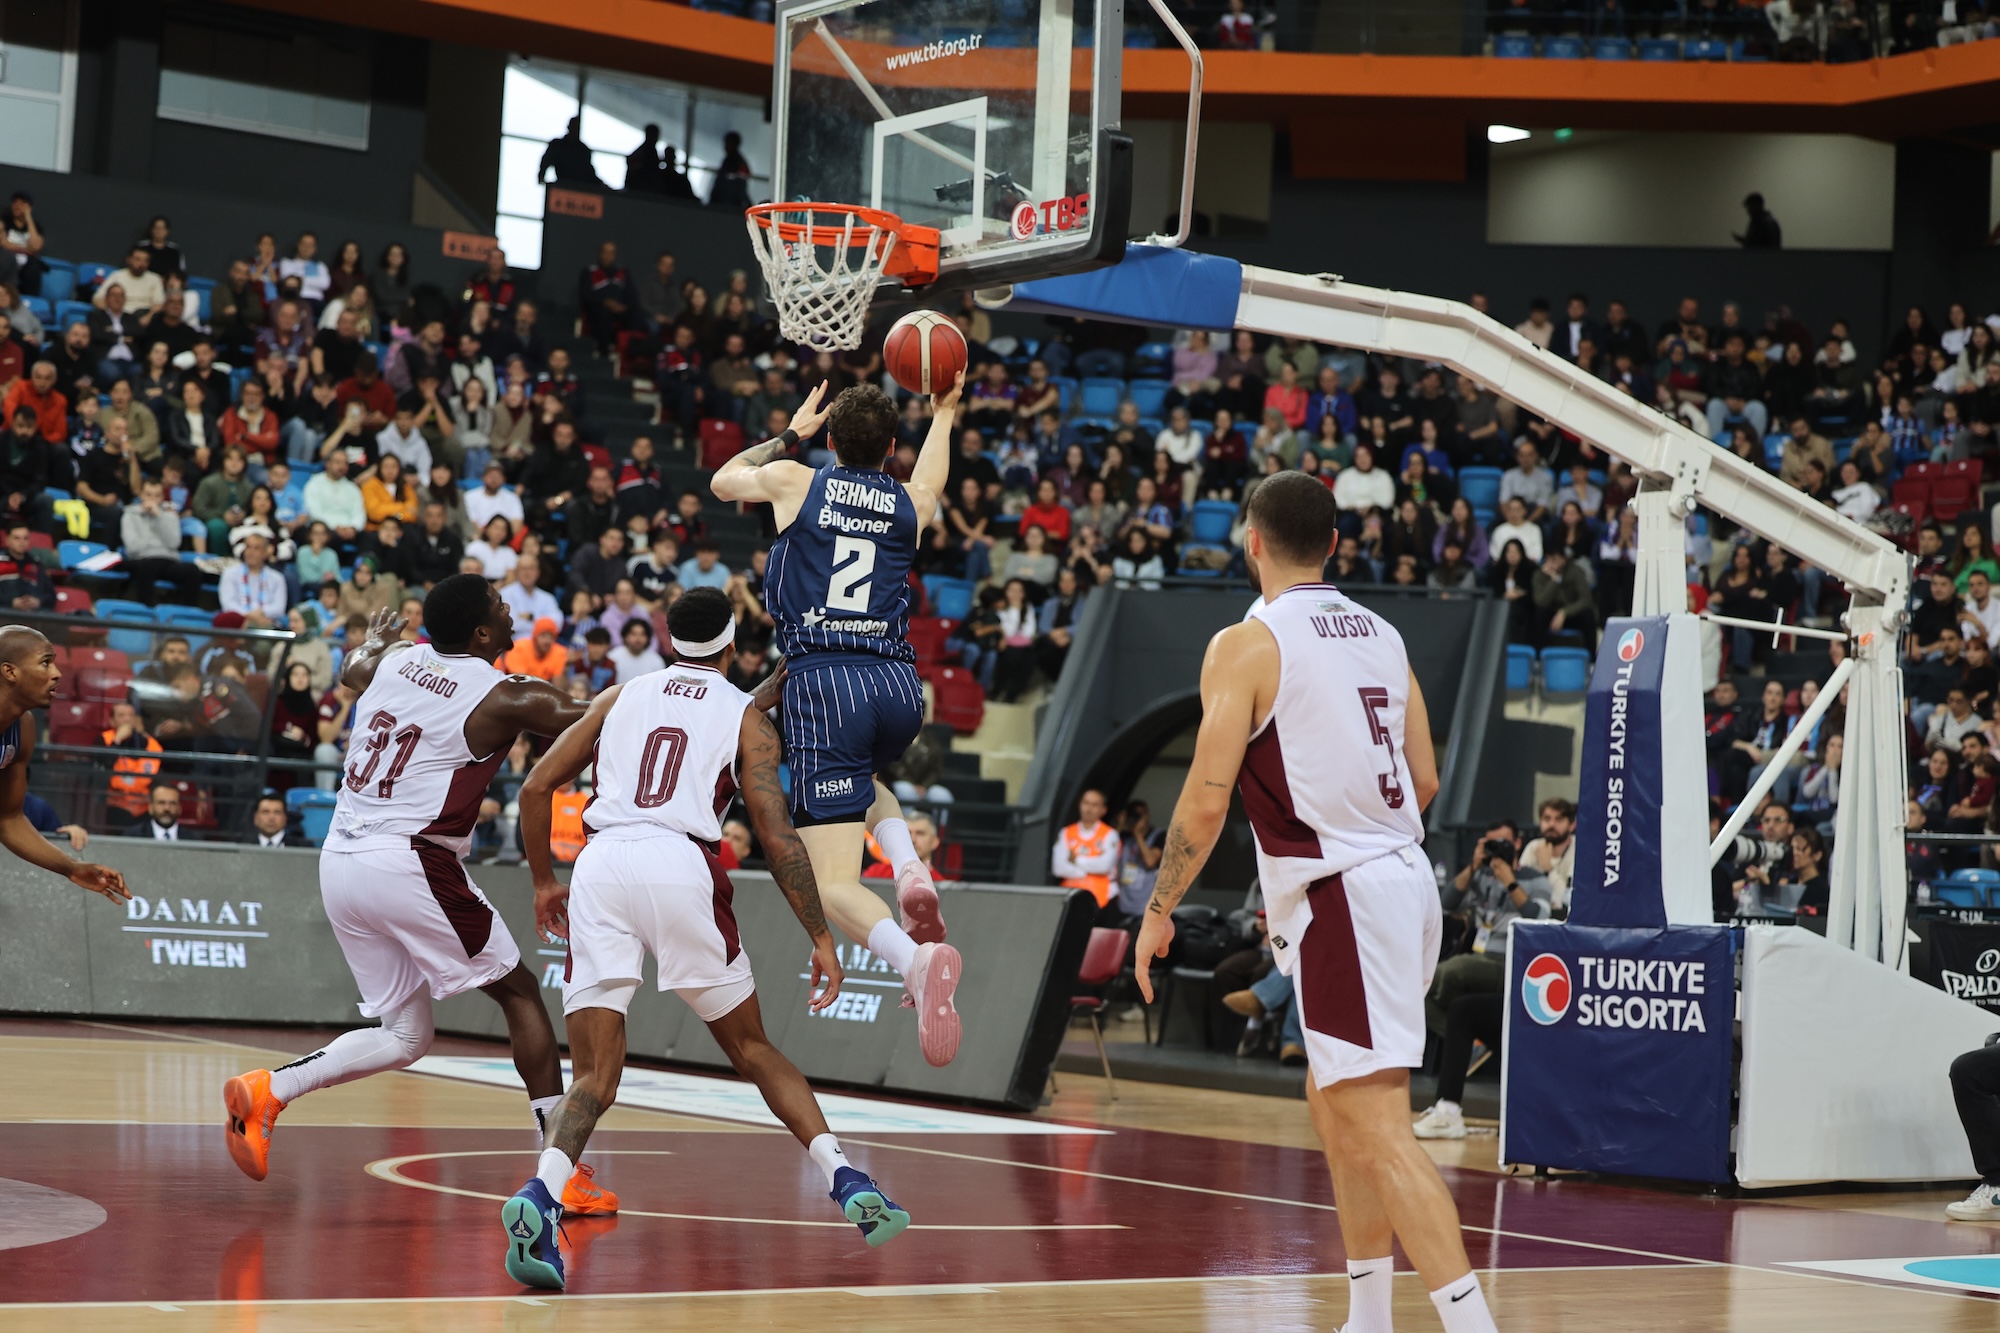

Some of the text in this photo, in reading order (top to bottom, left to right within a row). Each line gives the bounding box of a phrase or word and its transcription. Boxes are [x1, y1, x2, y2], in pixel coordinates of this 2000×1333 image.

[886, 33, 982, 71] www.tbf.org.tr
[1040, 193, 1090, 233] TBF
[824, 478, 897, 515] ŞEHMUS
[818, 504, 893, 534] Bilyoner
[826, 534, 877, 614] 2
[821, 619, 889, 633] corendon
[1309, 614, 1378, 638] ULUSOY
[398, 661, 459, 699] DELGADO
[662, 679, 709, 701] REED
[1608, 663, 1633, 770] TÜRKİYE
[346, 709, 423, 799] 31
[1357, 687, 1405, 809] 5
[634, 726, 689, 809] 0
[815, 777, 853, 794] HSM
[126, 895, 263, 926] DAMAT
[145, 938, 247, 968] TWEEN
[1578, 956, 1706, 995] TÜRKİYE
[1576, 993, 1707, 1033] SİGORTA
